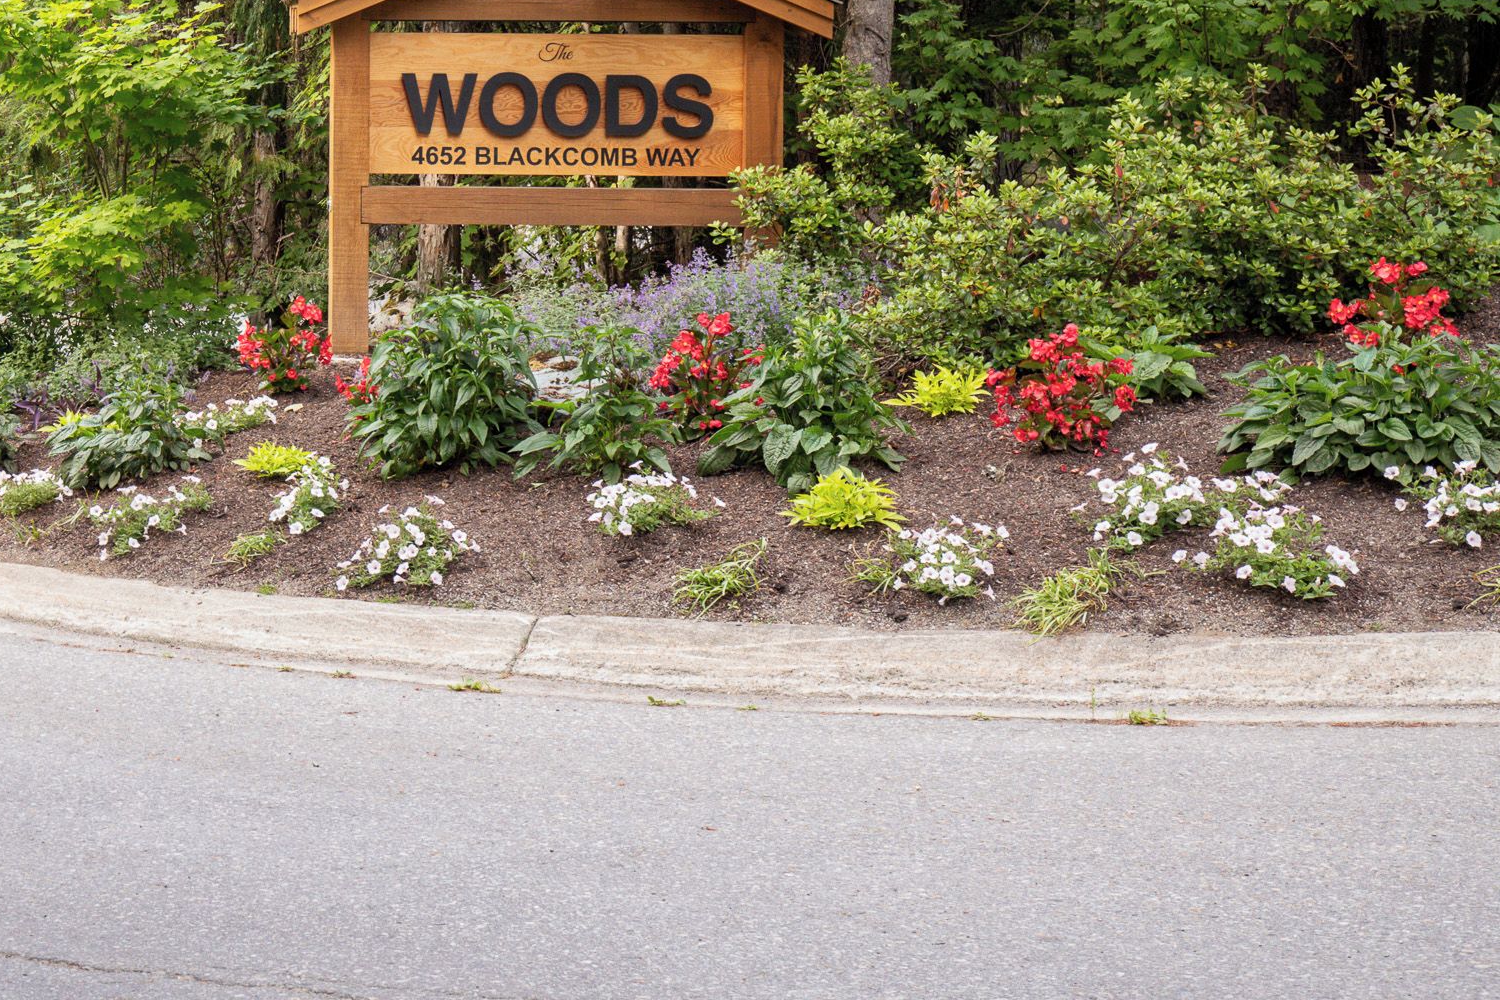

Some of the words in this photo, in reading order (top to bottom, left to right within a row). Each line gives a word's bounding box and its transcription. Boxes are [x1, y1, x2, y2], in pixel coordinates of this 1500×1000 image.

[538, 42, 573, 63] The
[402, 72, 714, 138] WOODS
[412, 146, 466, 166] 4652
[476, 146, 638, 167] BLACKCOMB
[645, 148, 701, 167] WAY
